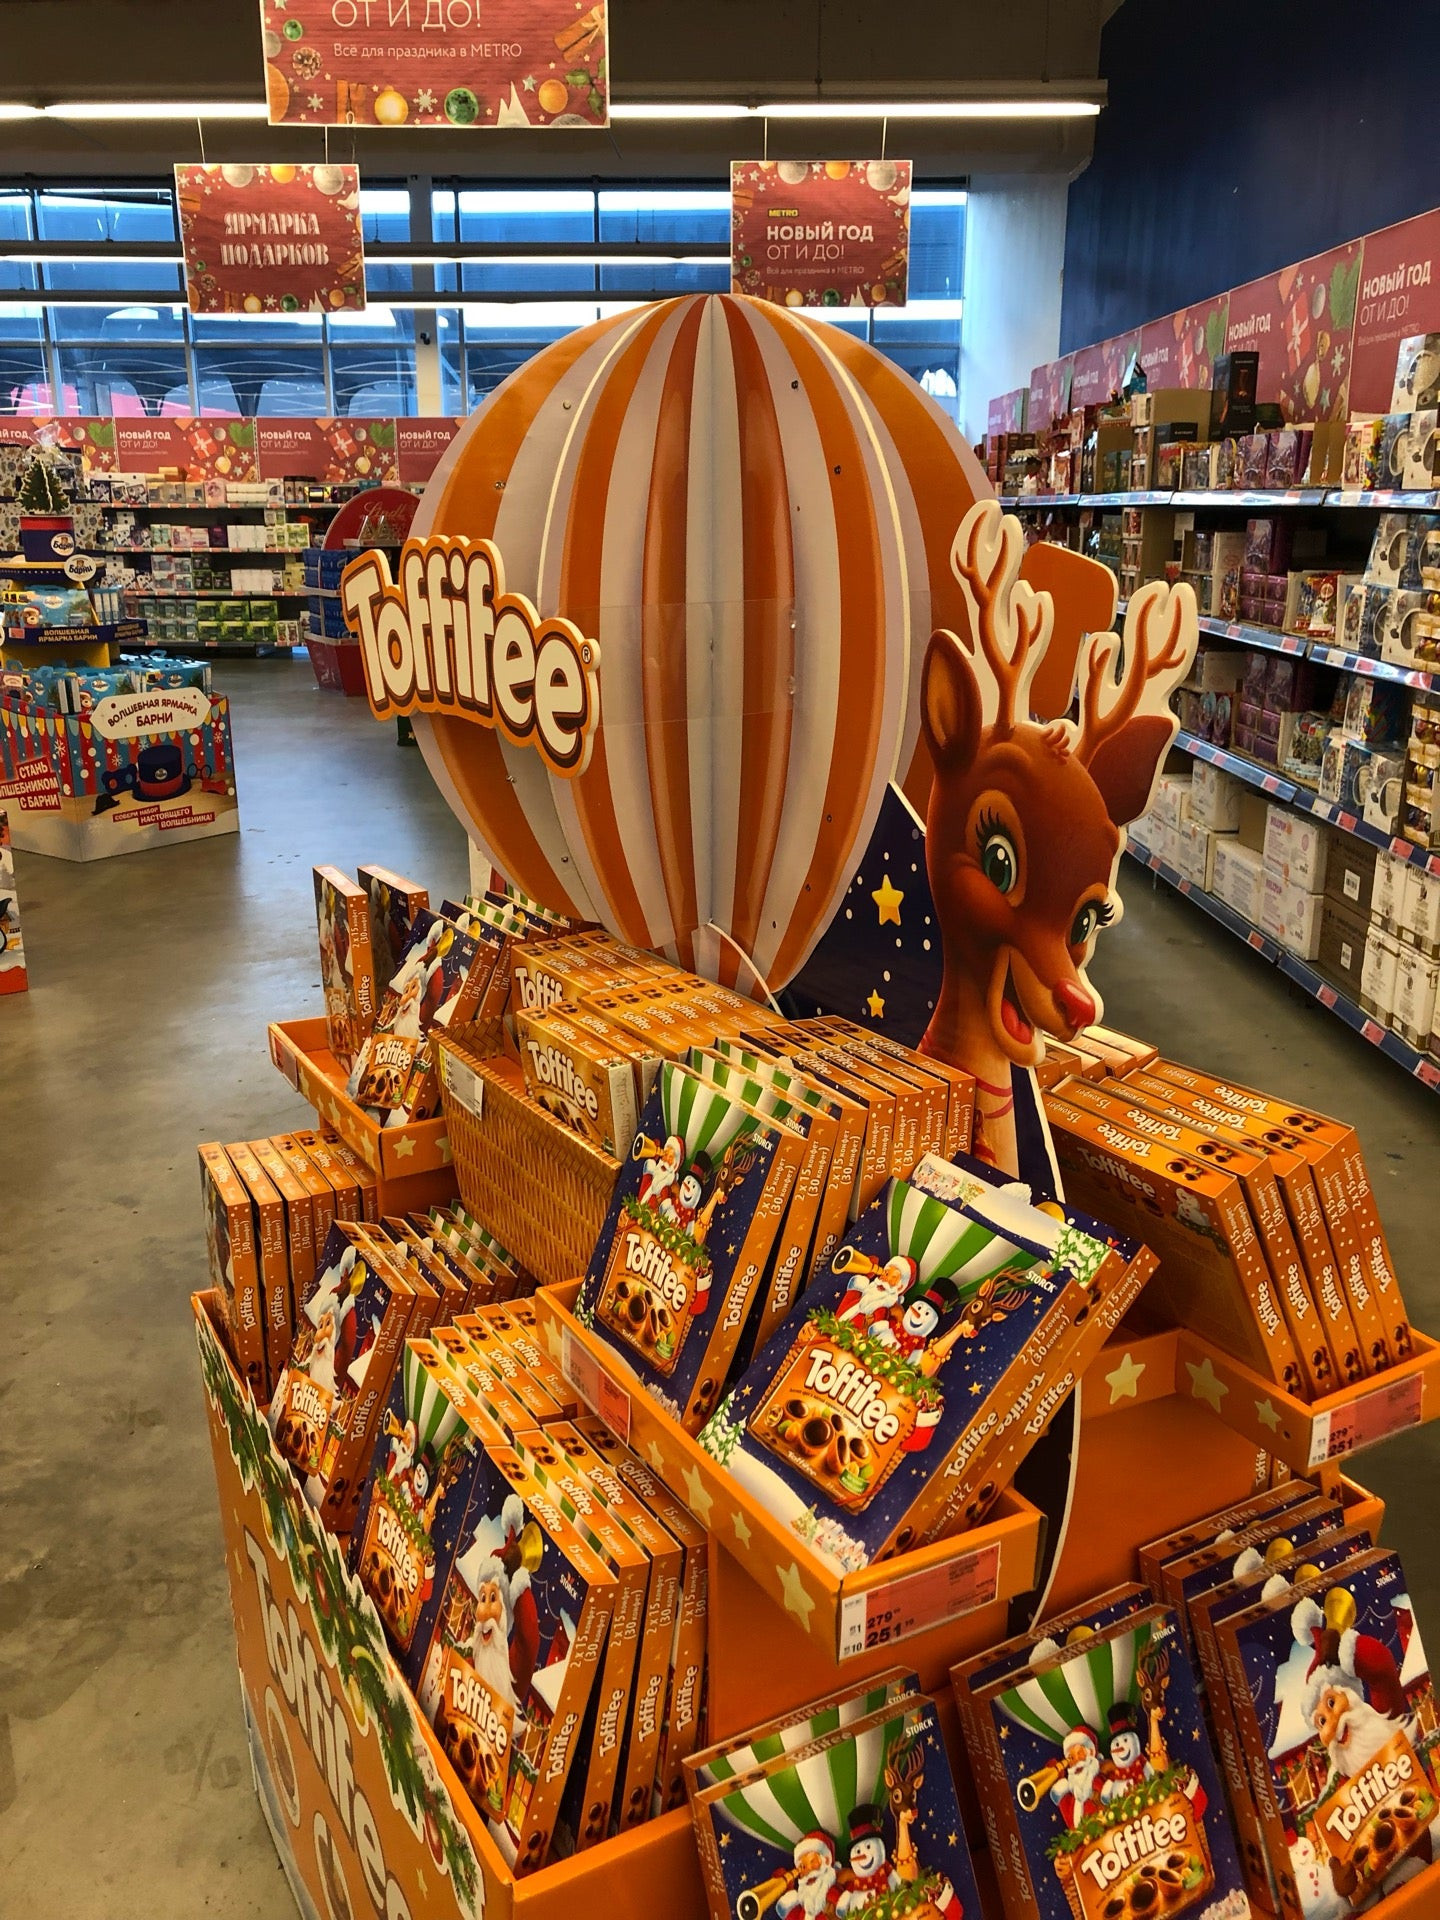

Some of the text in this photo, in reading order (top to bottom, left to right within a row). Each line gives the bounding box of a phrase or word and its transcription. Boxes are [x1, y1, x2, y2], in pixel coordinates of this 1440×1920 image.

[332, 0, 481, 32] ОТ И ДО!
[361, 47, 384, 58] для
[388, 47, 456, 60] праздника
[460, 48, 467, 57] в
[471, 44, 522, 57] METRO
[224, 212, 320, 234] ЯРМАРКА
[767, 221, 874, 242] НОВЫЙ ГОД
[221, 243, 329, 268] ПОДАРКОВ
[767, 244, 844, 262] ОТ И ДО!
[1362, 260, 1432, 300] НОВЫЙ ГОД
[1360, 294, 1410, 326] ОТ И ДО!
[1229, 313, 1271, 341] НОВЫЙ ГОД
[10, 431, 28, 440] ГОД
[119, 429, 171, 441] НОВЫЙ ГОД
[142, 441, 158, 449] ДО!
[260, 429, 311, 441] НОВЫЙ ГОД
[283, 441, 299, 449] ДО!
[400, 429, 451, 441] НОВЫЙ ГОД
[421, 441, 438, 449] ДО!
[68, 565, 93, 575] Барни
[343, 549, 587, 765] Toffifee
[108, 698, 198, 727] ВОЛШЕБНАЯ ЯРМАРКА
[137, 712, 173, 727] БАРНИ
[19, 762, 48, 779] СТАНЬ
[0, 777, 59, 797] ЛШЕБНИКОМ
[20, 794, 59, 808] С БАРНИ
[358, 975, 372, 1018] Toffifee
[667, 1001, 699, 1020] Toffifee
[689, 996, 722, 1014] Toffifee
[711, 990, 744, 1009] Toffifee
[547, 1021, 577, 1041] Toffifee
[579, 1016, 609, 1034] Toffifee
[620, 1011, 652, 1031] Toffifee
[644, 1006, 675, 1025] Toffifee
[374, 1040, 412, 1071] Toffifee
[817, 1048, 858, 1070] Toffifee
[842, 1041, 883, 1063] Toffifee
[867, 1036, 909, 1058] Toffifee
[792, 1052, 832, 1075] Toffifee
[526, 1040, 599, 1120] Toffifee
[1192, 1098, 1248, 1129] Toffifee
[1215, 1086, 1270, 1114] Toffifee
[786, 1117, 805, 1136] STORCK
[1097, 1123, 1153, 1157] Toffifee
[1126, 1109, 1182, 1141] Toffifee
[752, 1133, 773, 1151] STORCK
[764, 1185, 776, 1199] 15
[774, 1158, 786, 1186] конфет
[1076, 1147, 1156, 1198] Toffifee
[770, 1165, 796, 1216] (30 конфет)
[626, 1233, 688, 1312] Toffifee
[772, 1246, 802, 1313] Toffifee
[1371, 1236, 1392, 1293] Toffifee
[1026, 1270, 1056, 1293] STORCK
[1287, 1263, 1310, 1319] Toffifee
[1322, 1264, 1343, 1320] Toffifee
[1349, 1253, 1369, 1310] Toffifee
[244, 1286, 254, 1333] Toffifee
[275, 1286, 284, 1332] Toffifee
[722, 1264, 758, 1332] Toffifee
[1094, 1317, 1102, 1327] 2
[1107, 1293, 1120, 1307] 15
[1119, 1269, 1138, 1296] конфет
[1105, 1280, 1142, 1330] (30 конфет)
[1258, 1281, 1281, 1336] Toffifee
[1020, 1354, 1028, 1365] 2
[1032, 1330, 1046, 1345] 15
[1045, 1304, 1066, 1332] конфет
[1031, 1314, 1070, 1367] (30 конфет)
[488, 1348, 517, 1379] Toffifee
[511, 1338, 541, 1368] Toffifee
[438, 1376, 467, 1407] Toffifee
[464, 1362, 494, 1393] Toffifee
[291, 1382, 327, 1430] Toffifee
[804, 1348, 900, 1444] Toffifee
[1024, 1372, 1074, 1436] Toffifee
[350, 1390, 377, 1441] Toffifee
[944, 1410, 999, 1479] Toffifee
[1328, 1438, 1353, 1458] 251
[587, 1465, 624, 1505] Toffifee
[618, 1459, 656, 1497] Toffifee
[557, 1475, 593, 1515] Toffifee
[528, 1492, 563, 1532] Toffifee
[377, 1506, 418, 1594] Toffifee
[560, 1574, 578, 1599] STORCK
[1376, 1572, 1397, 1588] STORCK
[866, 1623, 902, 1648] 251
[868, 1611, 892, 1629] 279
[1152, 1626, 1176, 1642] STORCK
[851, 1642, 862, 1653] 10
[450, 1668, 508, 1756] Toffifee
[639, 1674, 662, 1742] Toffifee
[676, 1665, 697, 1732] Toffifee
[599, 1689, 624, 1757] Toffifee
[905, 1718, 934, 1738] STORCK
[546, 1712, 578, 1783] Toffifee
[786, 1731, 852, 1763] Toffifee
[1252, 1756, 1276, 1821] Toffifee
[1326, 1751, 1413, 1841] Toffifee
[1010, 1832, 1032, 1902] Toffifee
[1081, 1813, 1187, 1890] Toffifee
